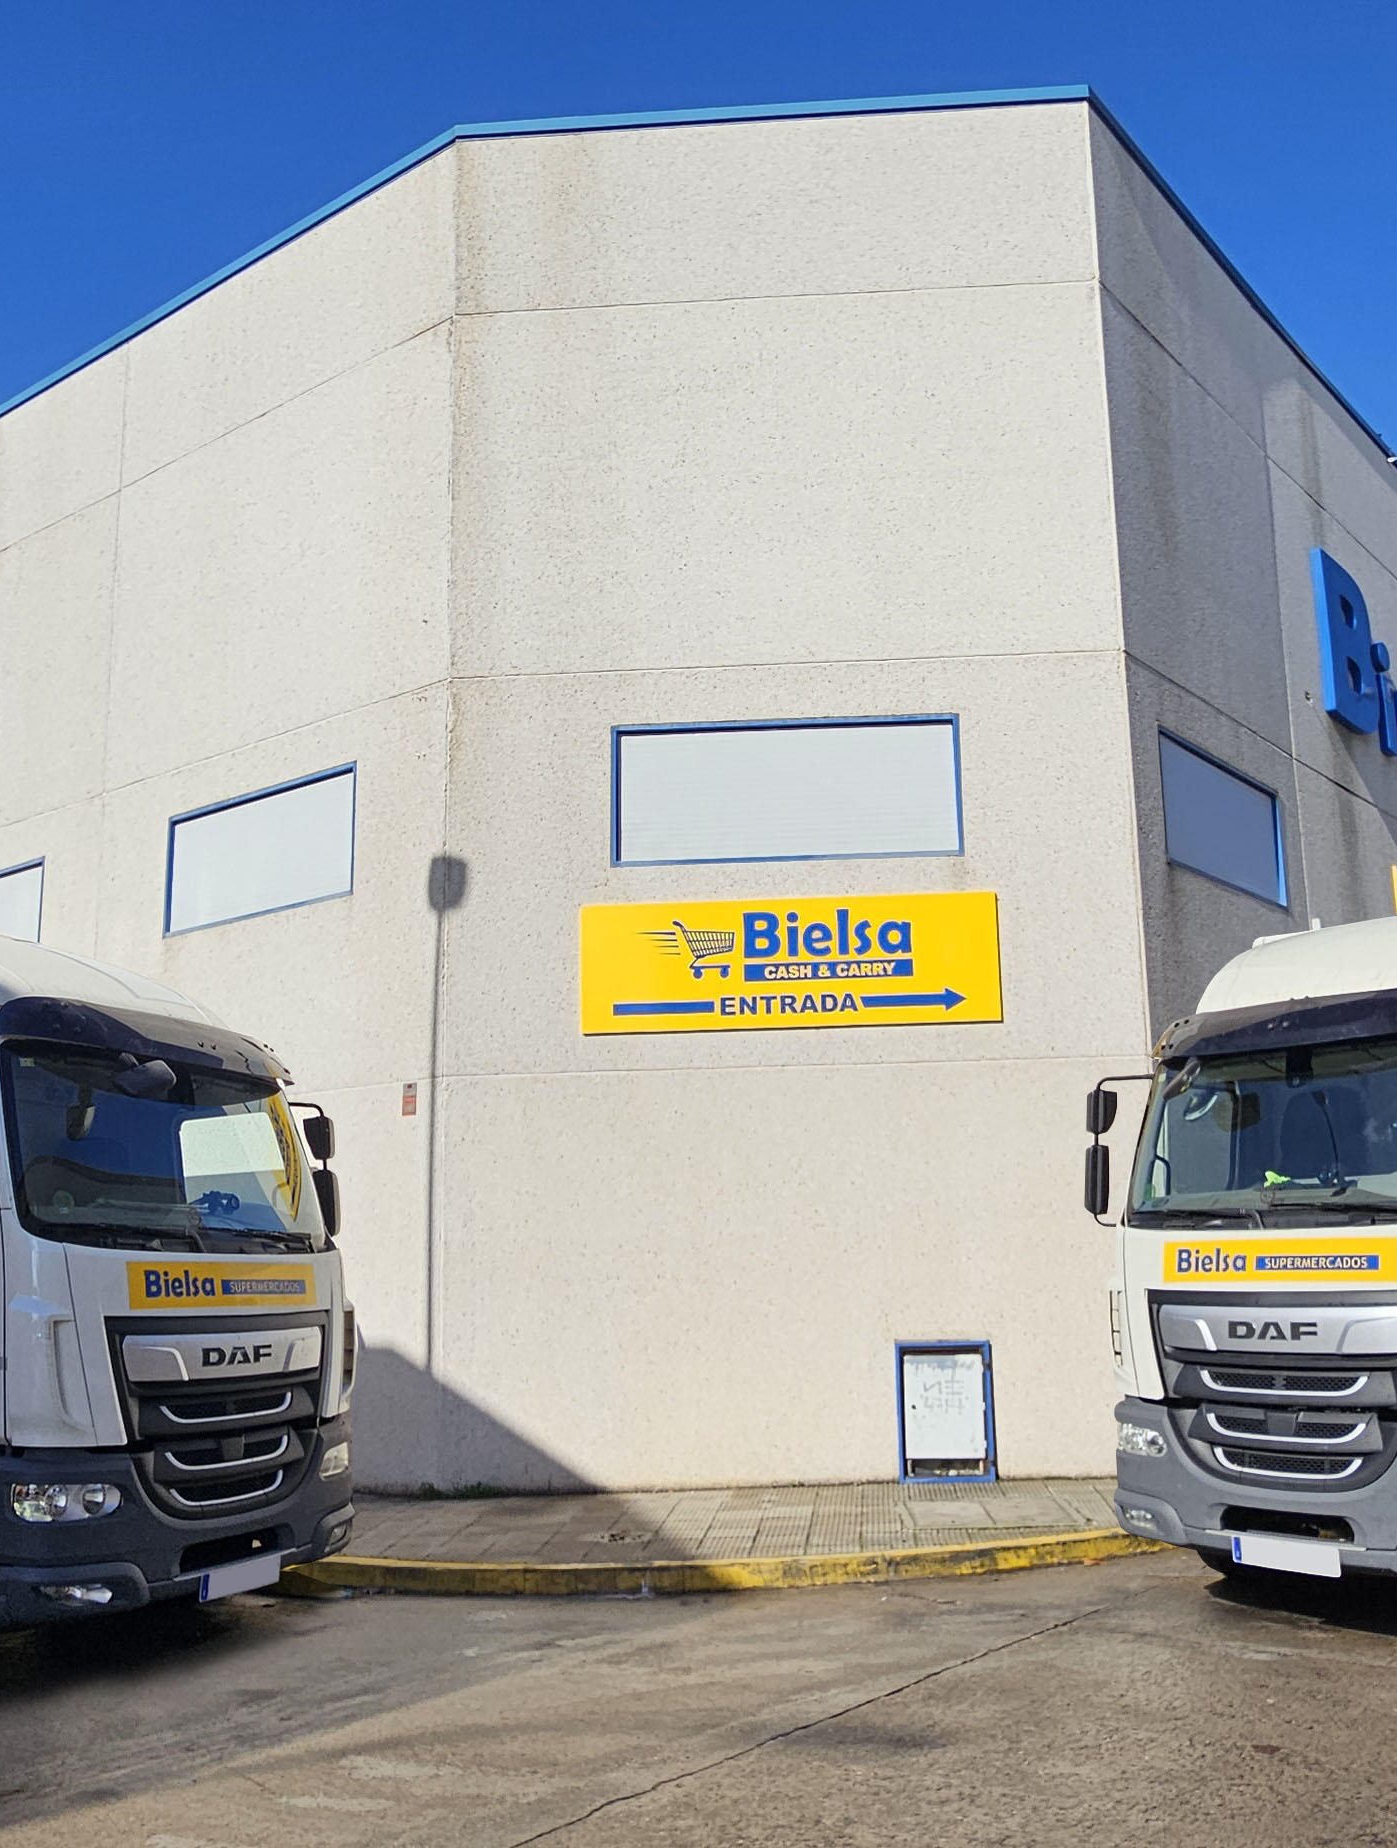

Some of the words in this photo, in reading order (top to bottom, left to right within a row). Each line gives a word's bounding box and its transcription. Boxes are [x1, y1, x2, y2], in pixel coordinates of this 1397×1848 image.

[743, 908, 912, 959] Bielsa
[764, 964, 812, 979] CASH
[818, 963, 831, 978] &
[836, 962, 896, 977] CARRY
[720, 993, 859, 1016] ENTRADA
[1177, 1248, 1247, 1273] Bielsa
[1265, 1256, 1369, 1269] SUPERMERCADOS
[144, 1269, 216, 1299] Bielsa
[228, 1280, 301, 1293] SUPERMERCADOS
[1228, 1321, 1318, 1341] DAF
[202, 1344, 272, 1367] DAF
